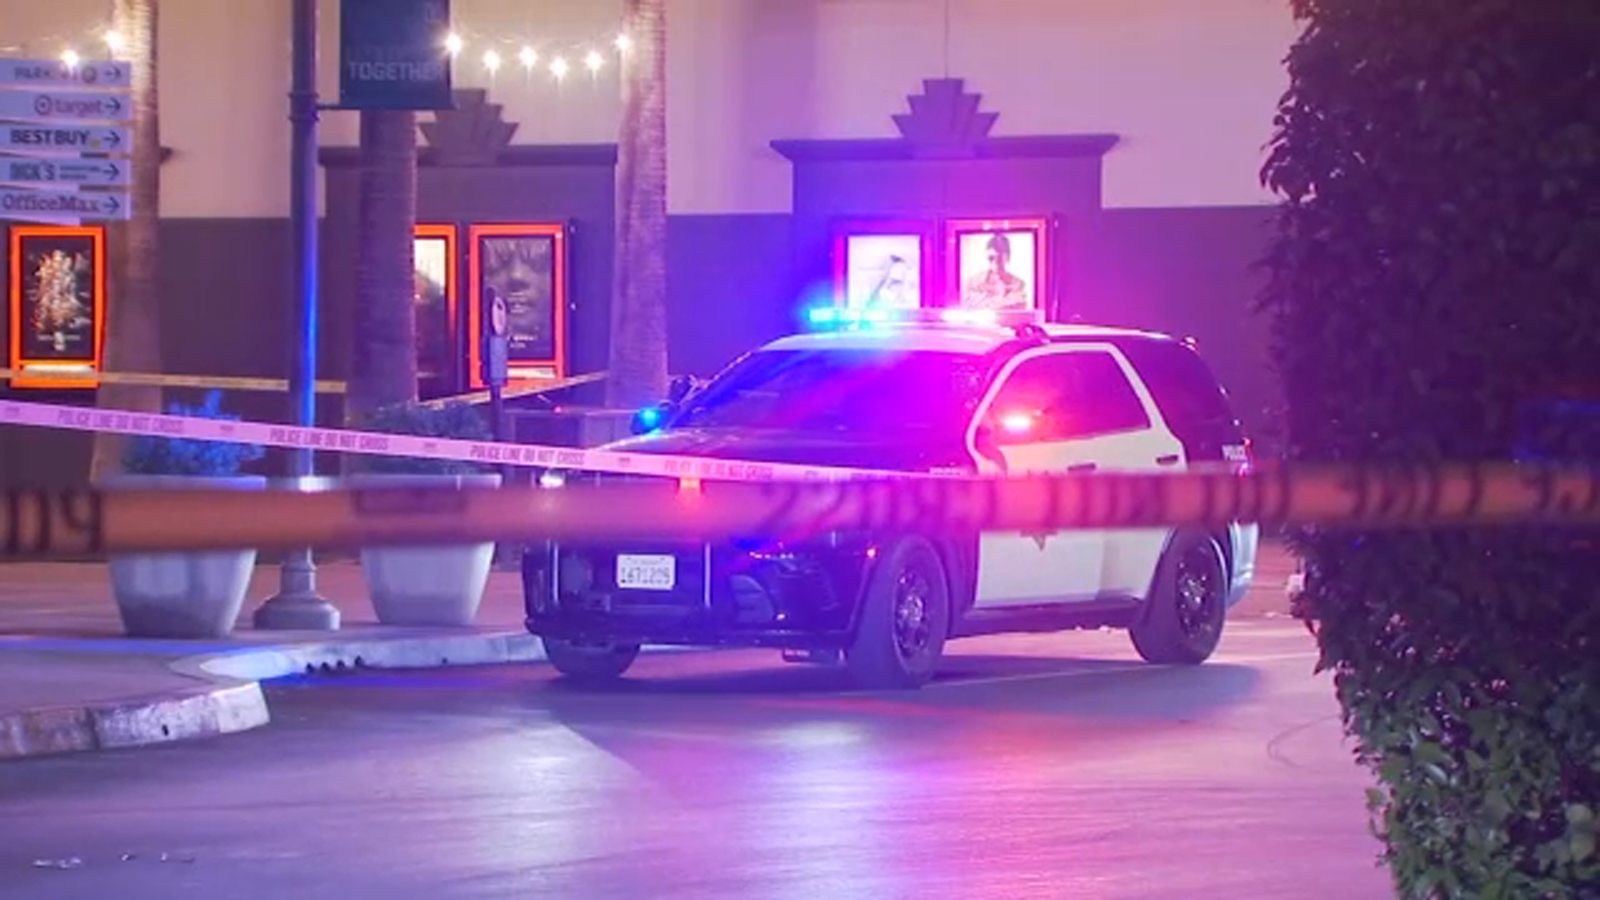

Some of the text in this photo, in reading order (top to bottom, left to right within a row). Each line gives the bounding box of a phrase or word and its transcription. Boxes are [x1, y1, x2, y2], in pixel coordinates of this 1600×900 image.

[55, 99, 102, 117] target
[10, 128, 90, 145] BEST BUY
[2, 193, 99, 212] OfficeMax
[116, 413, 130, 430] DO
[131, 415, 149, 432] NOT
[324, 431, 338, 448] DO
[339, 433, 357, 449] NOT
[522, 448, 535, 462] DO
[537, 450, 555, 463] NOT
